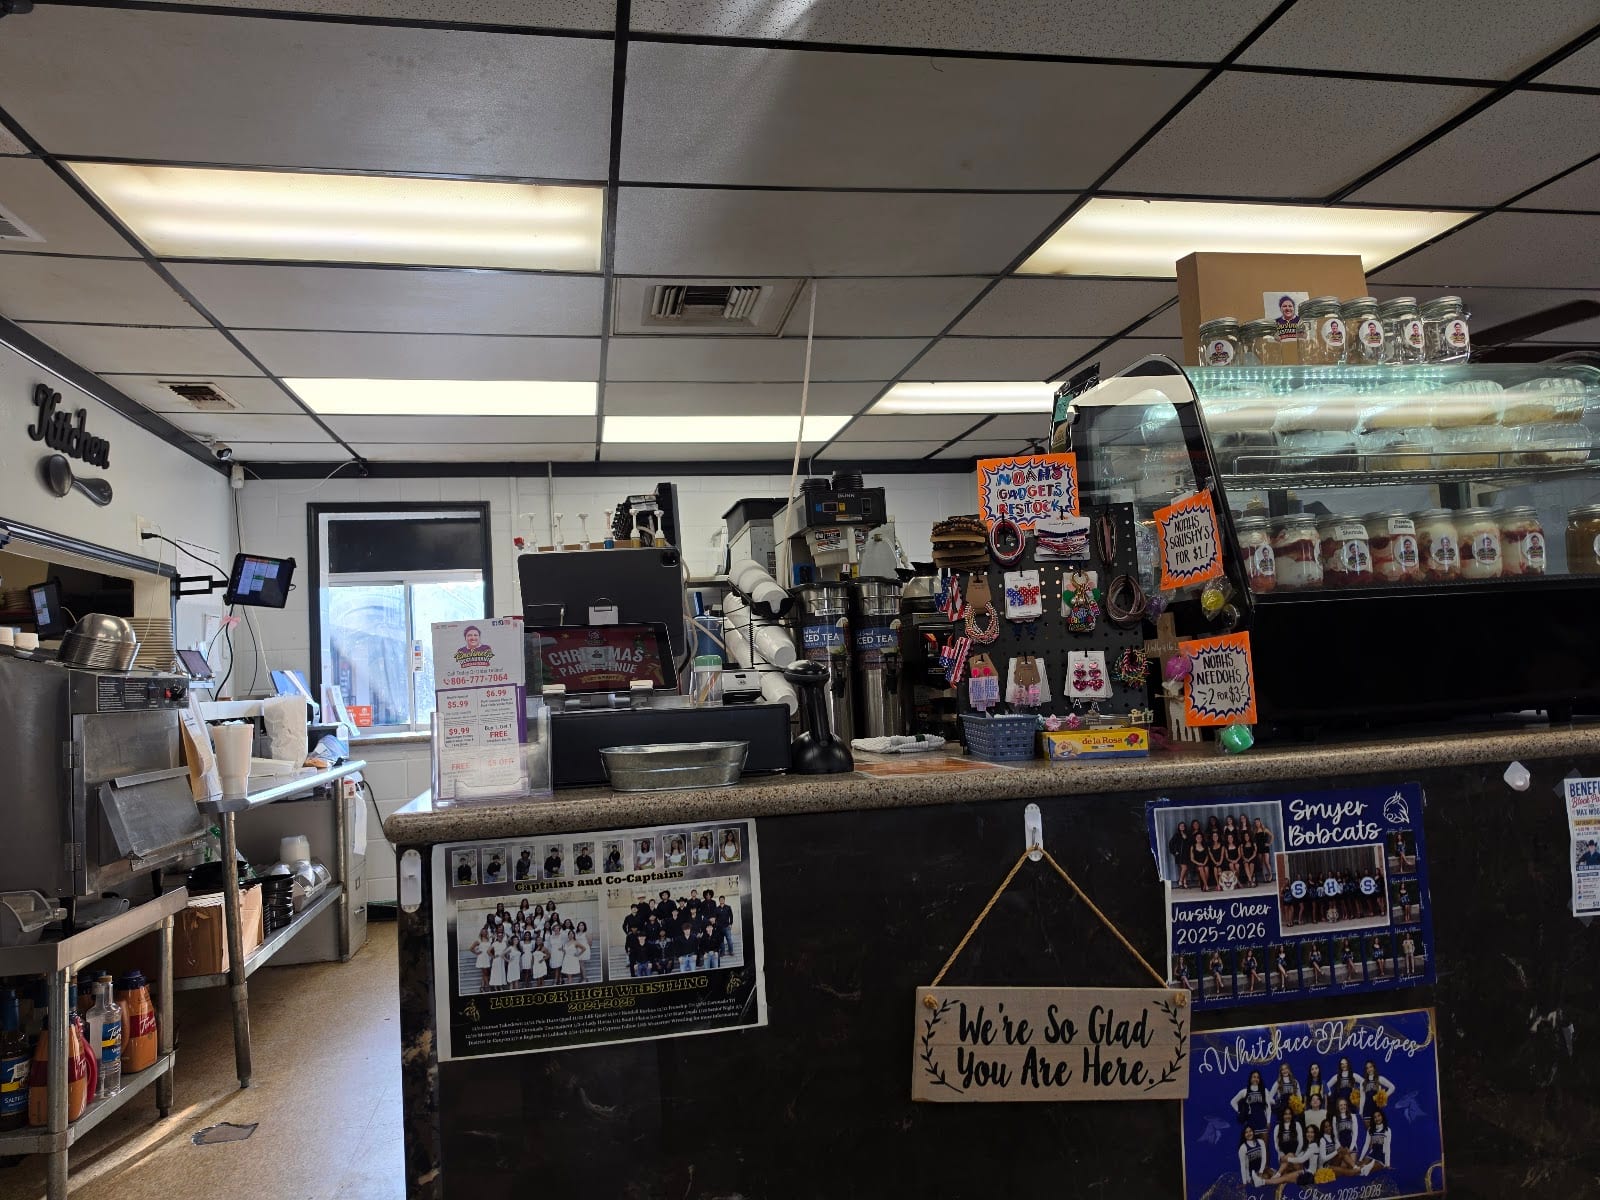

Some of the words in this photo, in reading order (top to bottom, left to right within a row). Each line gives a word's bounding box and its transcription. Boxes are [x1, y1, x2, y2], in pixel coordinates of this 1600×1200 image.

[28, 383, 110, 469] Kitchen
[997, 482, 1065, 501] GADGETS
[997, 499, 1060, 517] RESTOCK
[1175, 549, 1190, 565] FOR
[821, 632, 839, 641] TEA
[876, 634, 893, 643] TEA
[450, 673, 508, 685] 806-777-7064
[486, 689, 507, 698] $6.99
[1208, 688, 1216, 705] 2
[1217, 691, 1228, 700] FOR
[1229, 686, 1241, 706] $3
[447, 700, 469, 709] $5.99
[448, 727, 470, 736] $9.99
[489, 730, 508, 738] FREE
[1102, 736, 1123, 744] Rosa
[1571, 796, 1591, 808] Block
[1288, 799, 1368, 825] Smyer
[1288, 820, 1383, 847] Bobcats
[514, 879, 574, 893] Captains
[577, 876, 602, 887] and
[605, 868, 685, 885] Co-Captains
[1294, 884, 1304, 897] S
[1326, 880, 1336, 893] H
[1363, 878, 1373, 892] S
[1230, 902, 1272, 918] Cheer
[1177, 922, 1266, 945] 2025-2026
[490, 989, 570, 1010] LUBBOCK
[571, 985, 614, 1001] HIGH
[616, 975, 709, 998] WRESTLING
[567, 997, 636, 1014] 2024-2025
[958, 1002, 1034, 1046] We're
[1044, 1004, 1078, 1044] So
[1088, 1005, 1154, 1049] Glad
[1199, 1029, 1312, 1075] Whiteface
[1315, 1021, 1421, 1063] Antelopes
[957, 1046, 1012, 1089] You
[1020, 1046, 1072, 1088] Are
[1082, 1045, 1155, 1086] Here.
